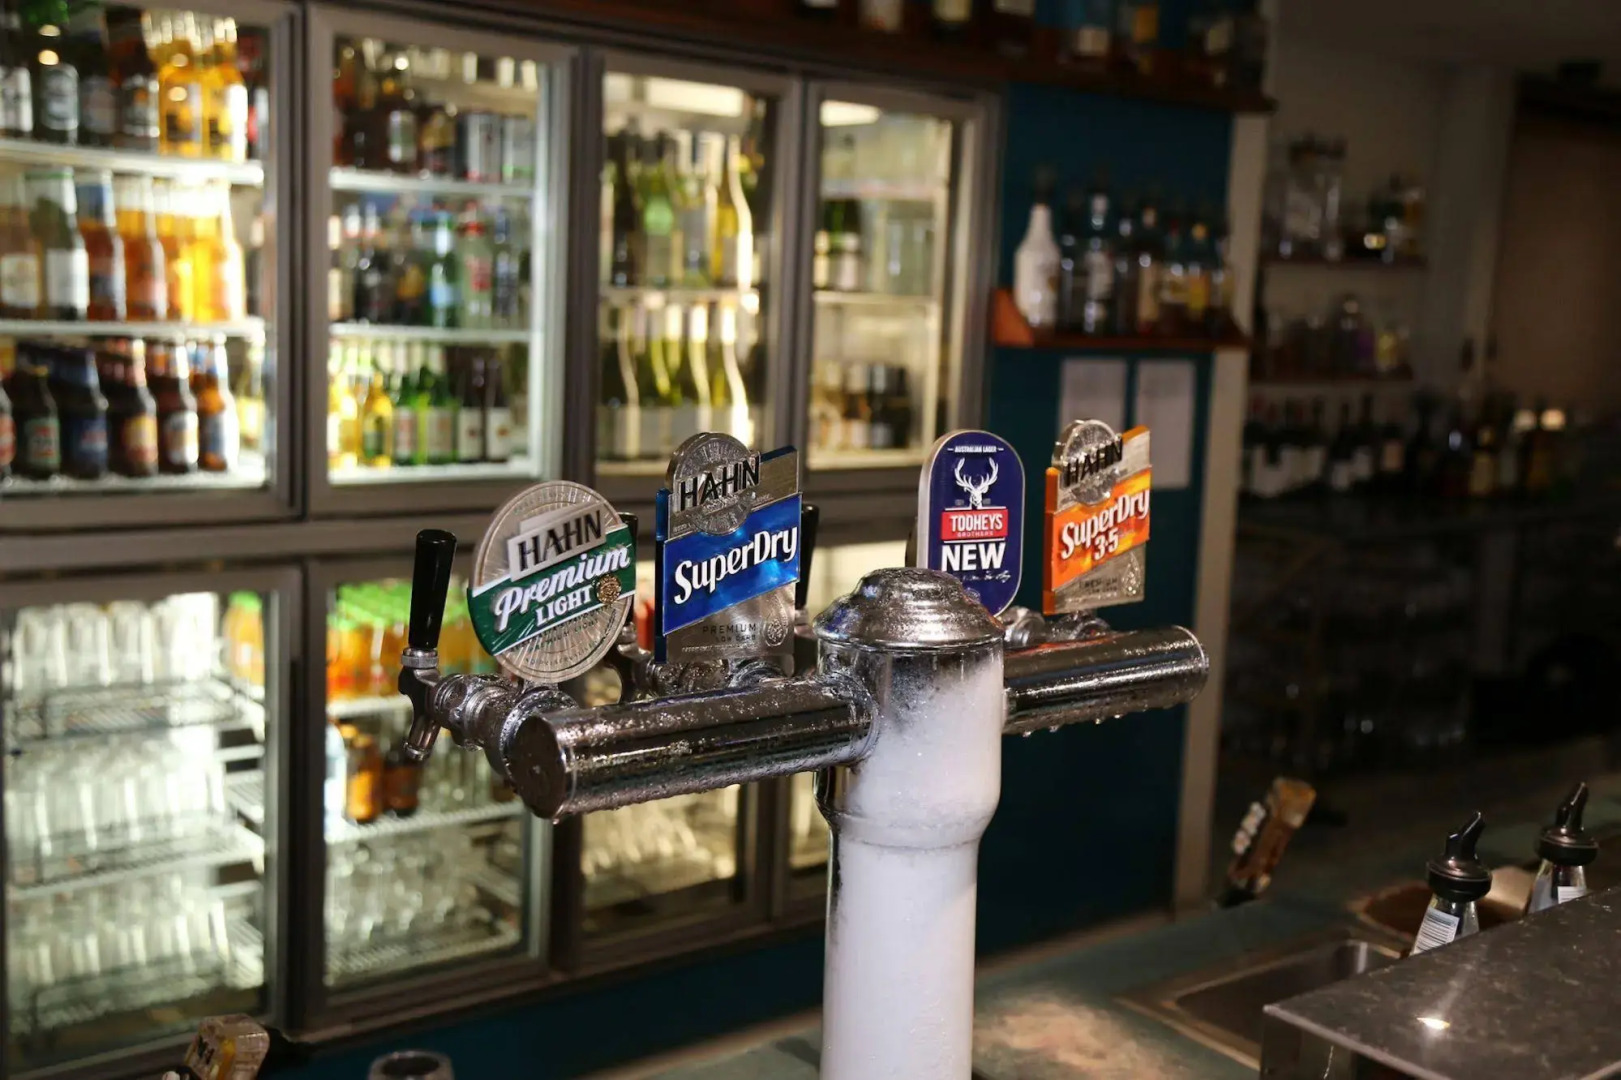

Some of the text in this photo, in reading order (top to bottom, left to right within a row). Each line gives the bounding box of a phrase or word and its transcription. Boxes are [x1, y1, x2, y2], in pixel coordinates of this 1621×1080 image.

[680, 455, 760, 511] HAHN
[1064, 438, 1123, 488] HAHN
[517, 509, 602, 571] HAHN
[950, 514, 1003, 532] TOOHEYS
[1061, 489, 1150, 559] SuperDry
[674, 526, 798, 605] SuperDry
[941, 542, 1007, 572] NEW
[494, 546, 631, 632] Premium
[535, 585, 594, 627] LIGHT
[702, 622, 757, 635] PREMIUM
